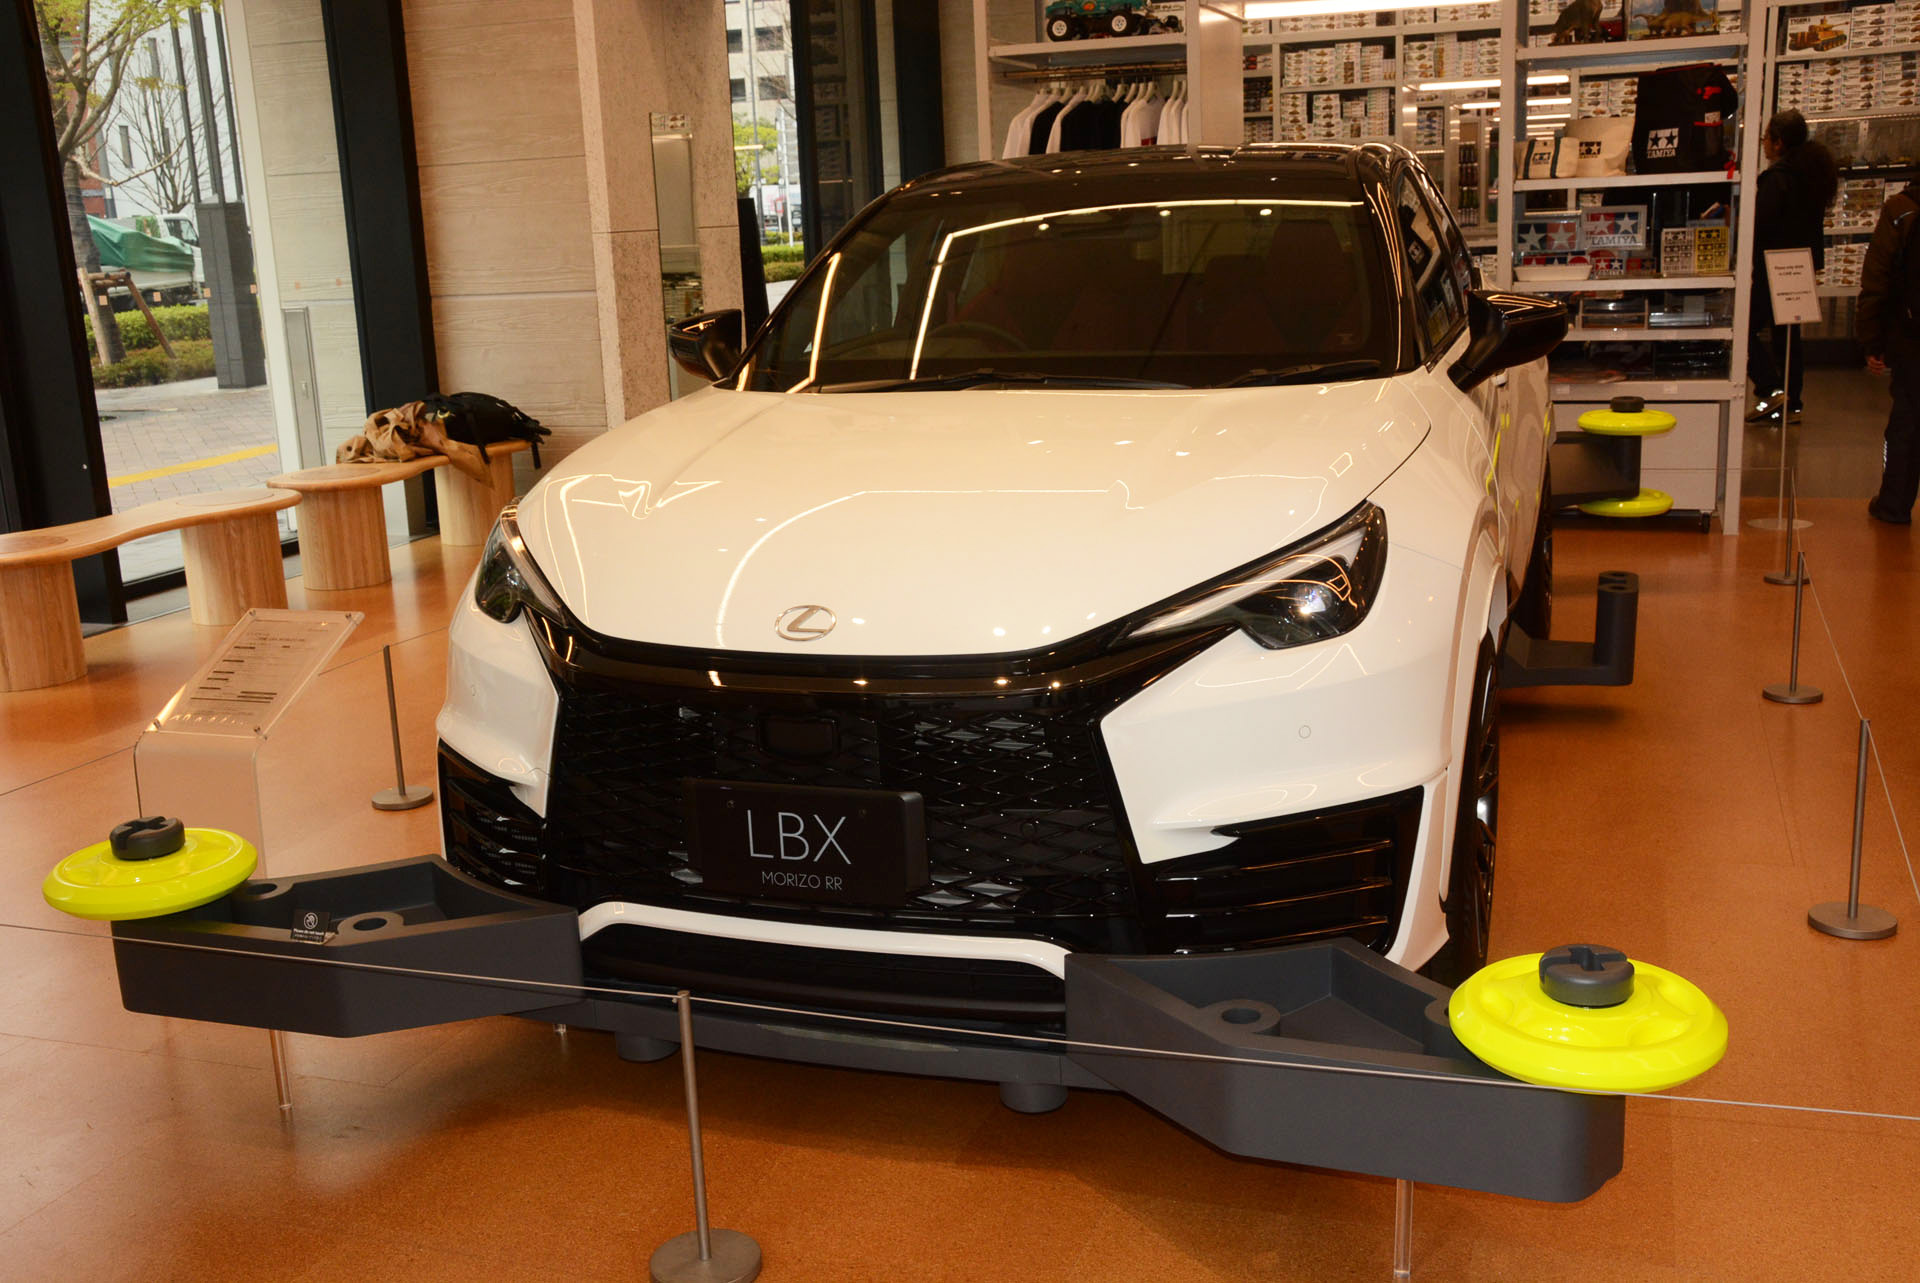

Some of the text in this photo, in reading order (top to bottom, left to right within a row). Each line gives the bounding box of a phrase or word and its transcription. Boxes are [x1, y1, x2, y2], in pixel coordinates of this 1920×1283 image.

[1647, 149, 1676, 159] TAMIYA
[1591, 235, 1638, 246] TAMIYA
[747, 809, 852, 865] LBX
[762, 871, 843, 891] MORIZO RR
